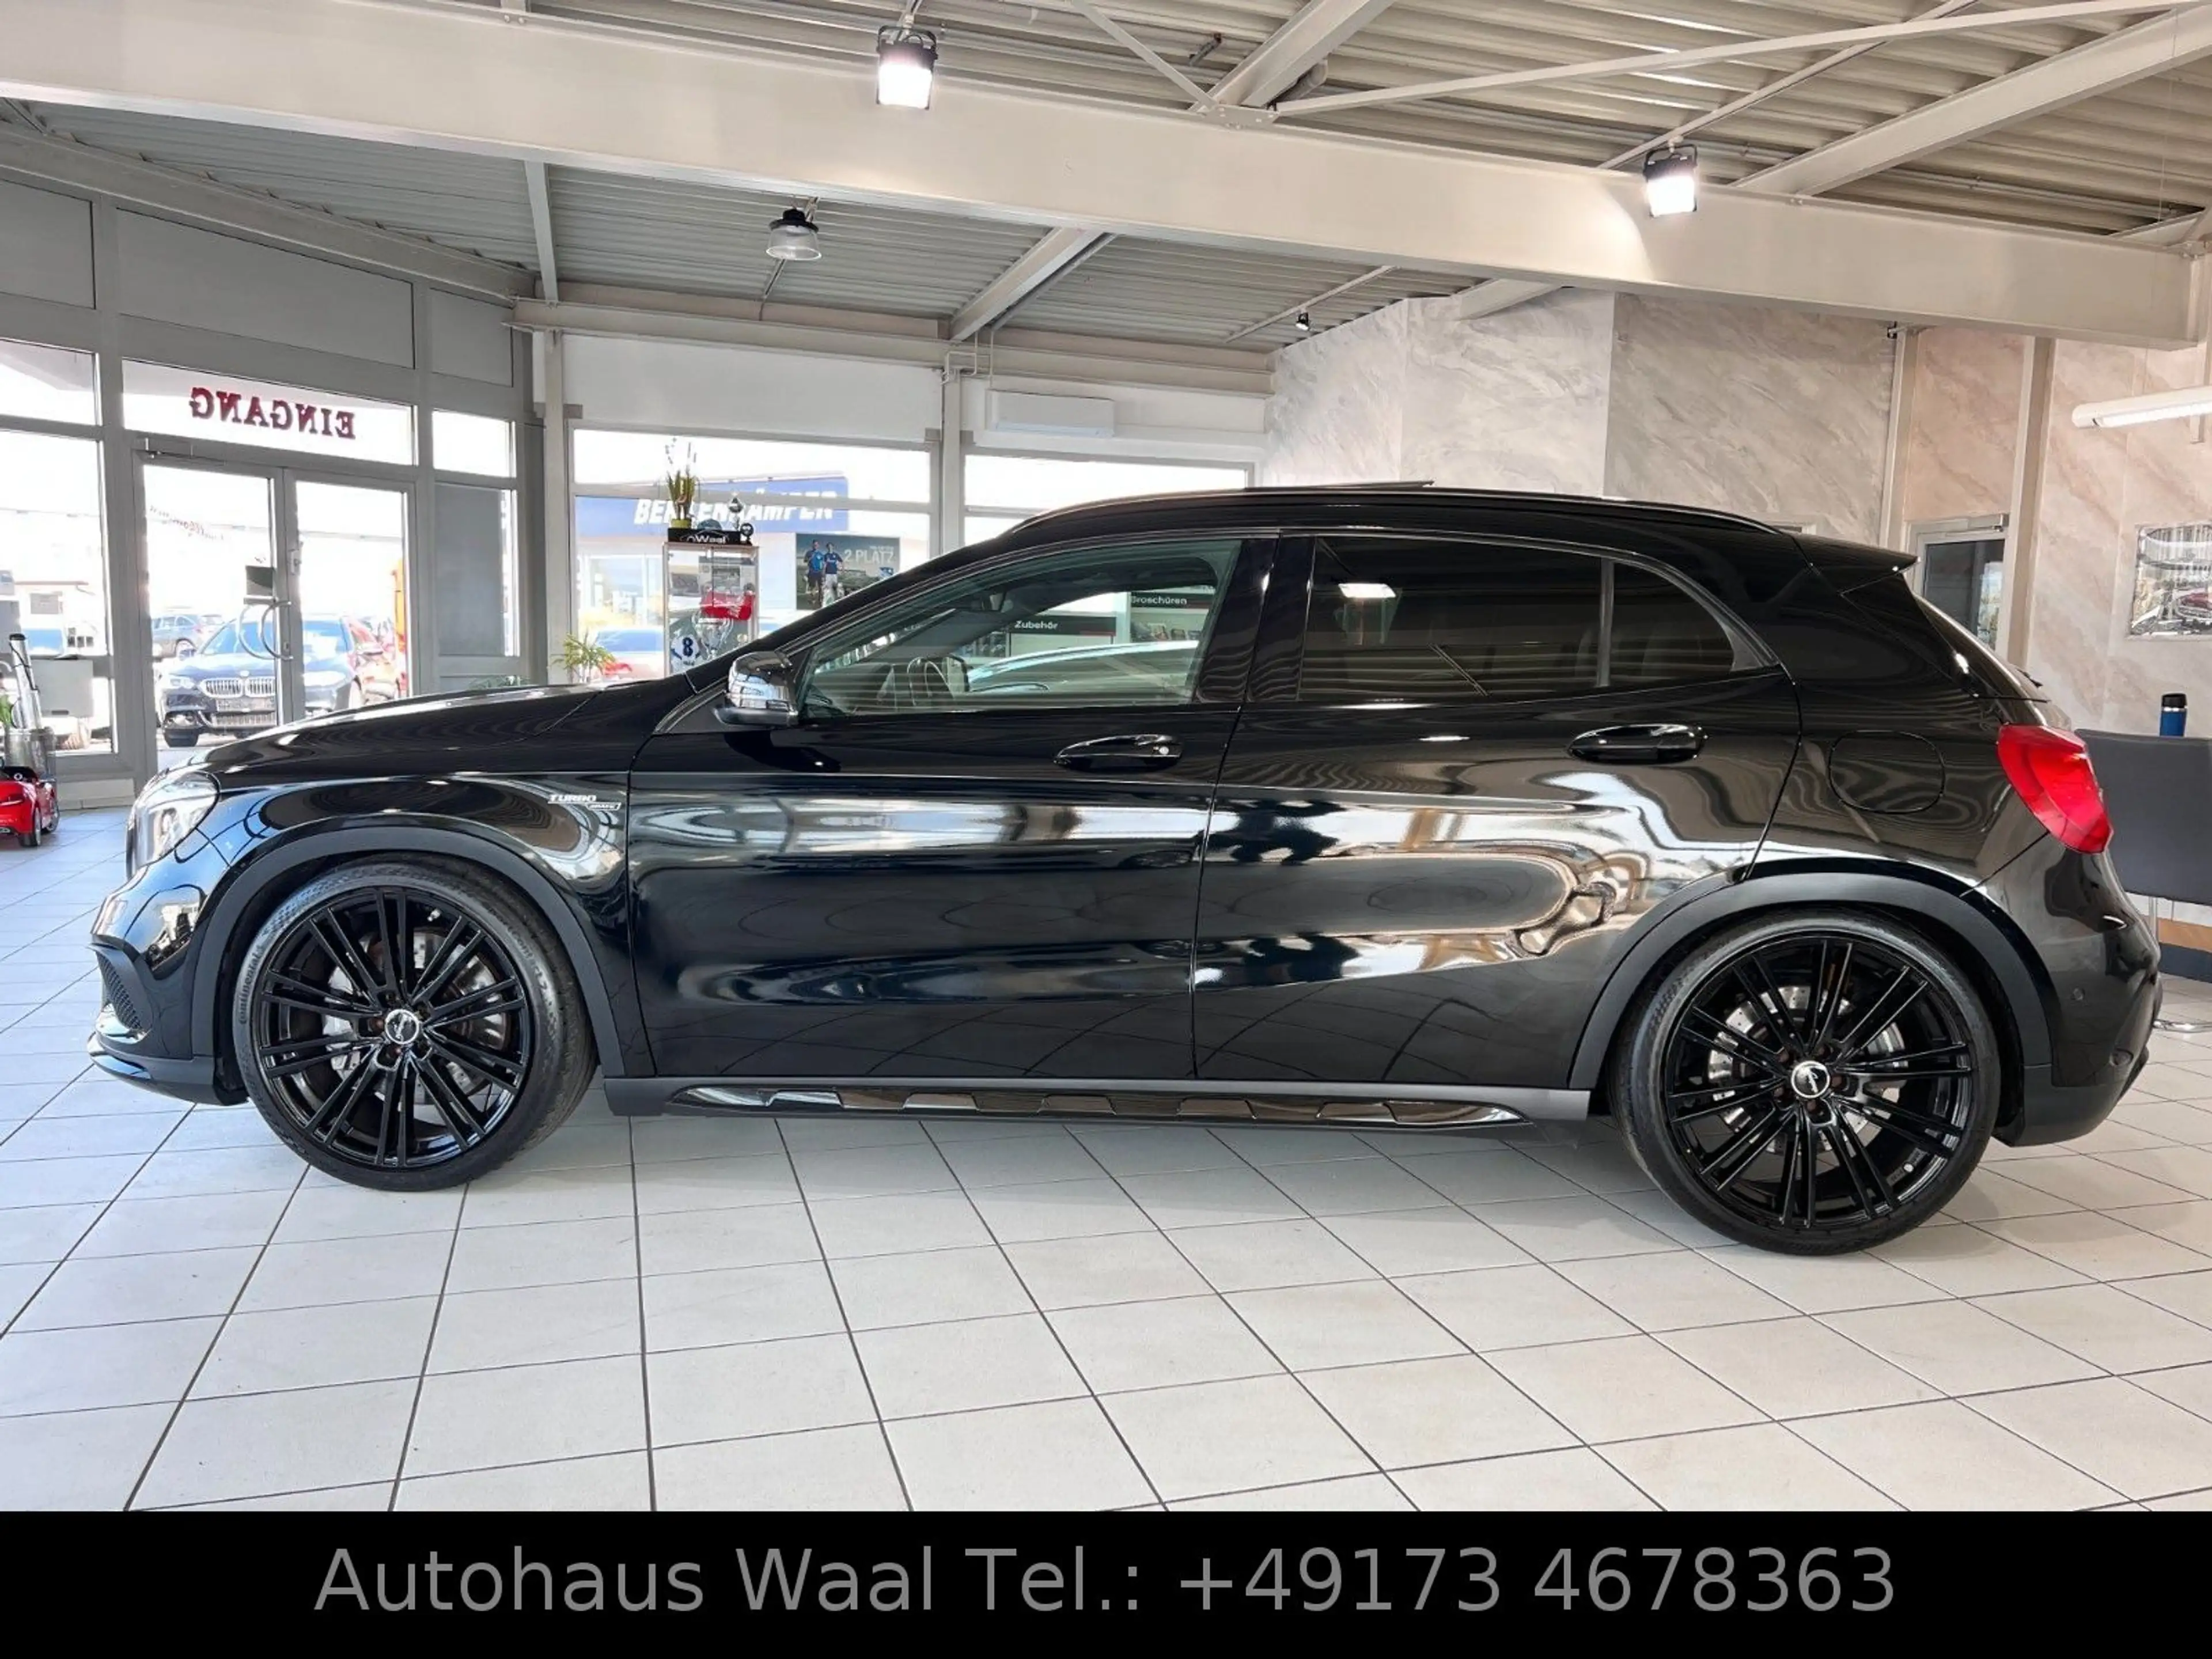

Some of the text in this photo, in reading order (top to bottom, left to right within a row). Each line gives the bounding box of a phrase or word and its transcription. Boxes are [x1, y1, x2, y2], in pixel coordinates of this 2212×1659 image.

[634, 488, 837, 525] BEENÄMPER
[844, 549, 894, 565] 2 PLATZ
[1014, 620, 1058, 630] Zubehör
[682, 637, 694, 657] 8
[238, 951, 262, 1025] Continental
